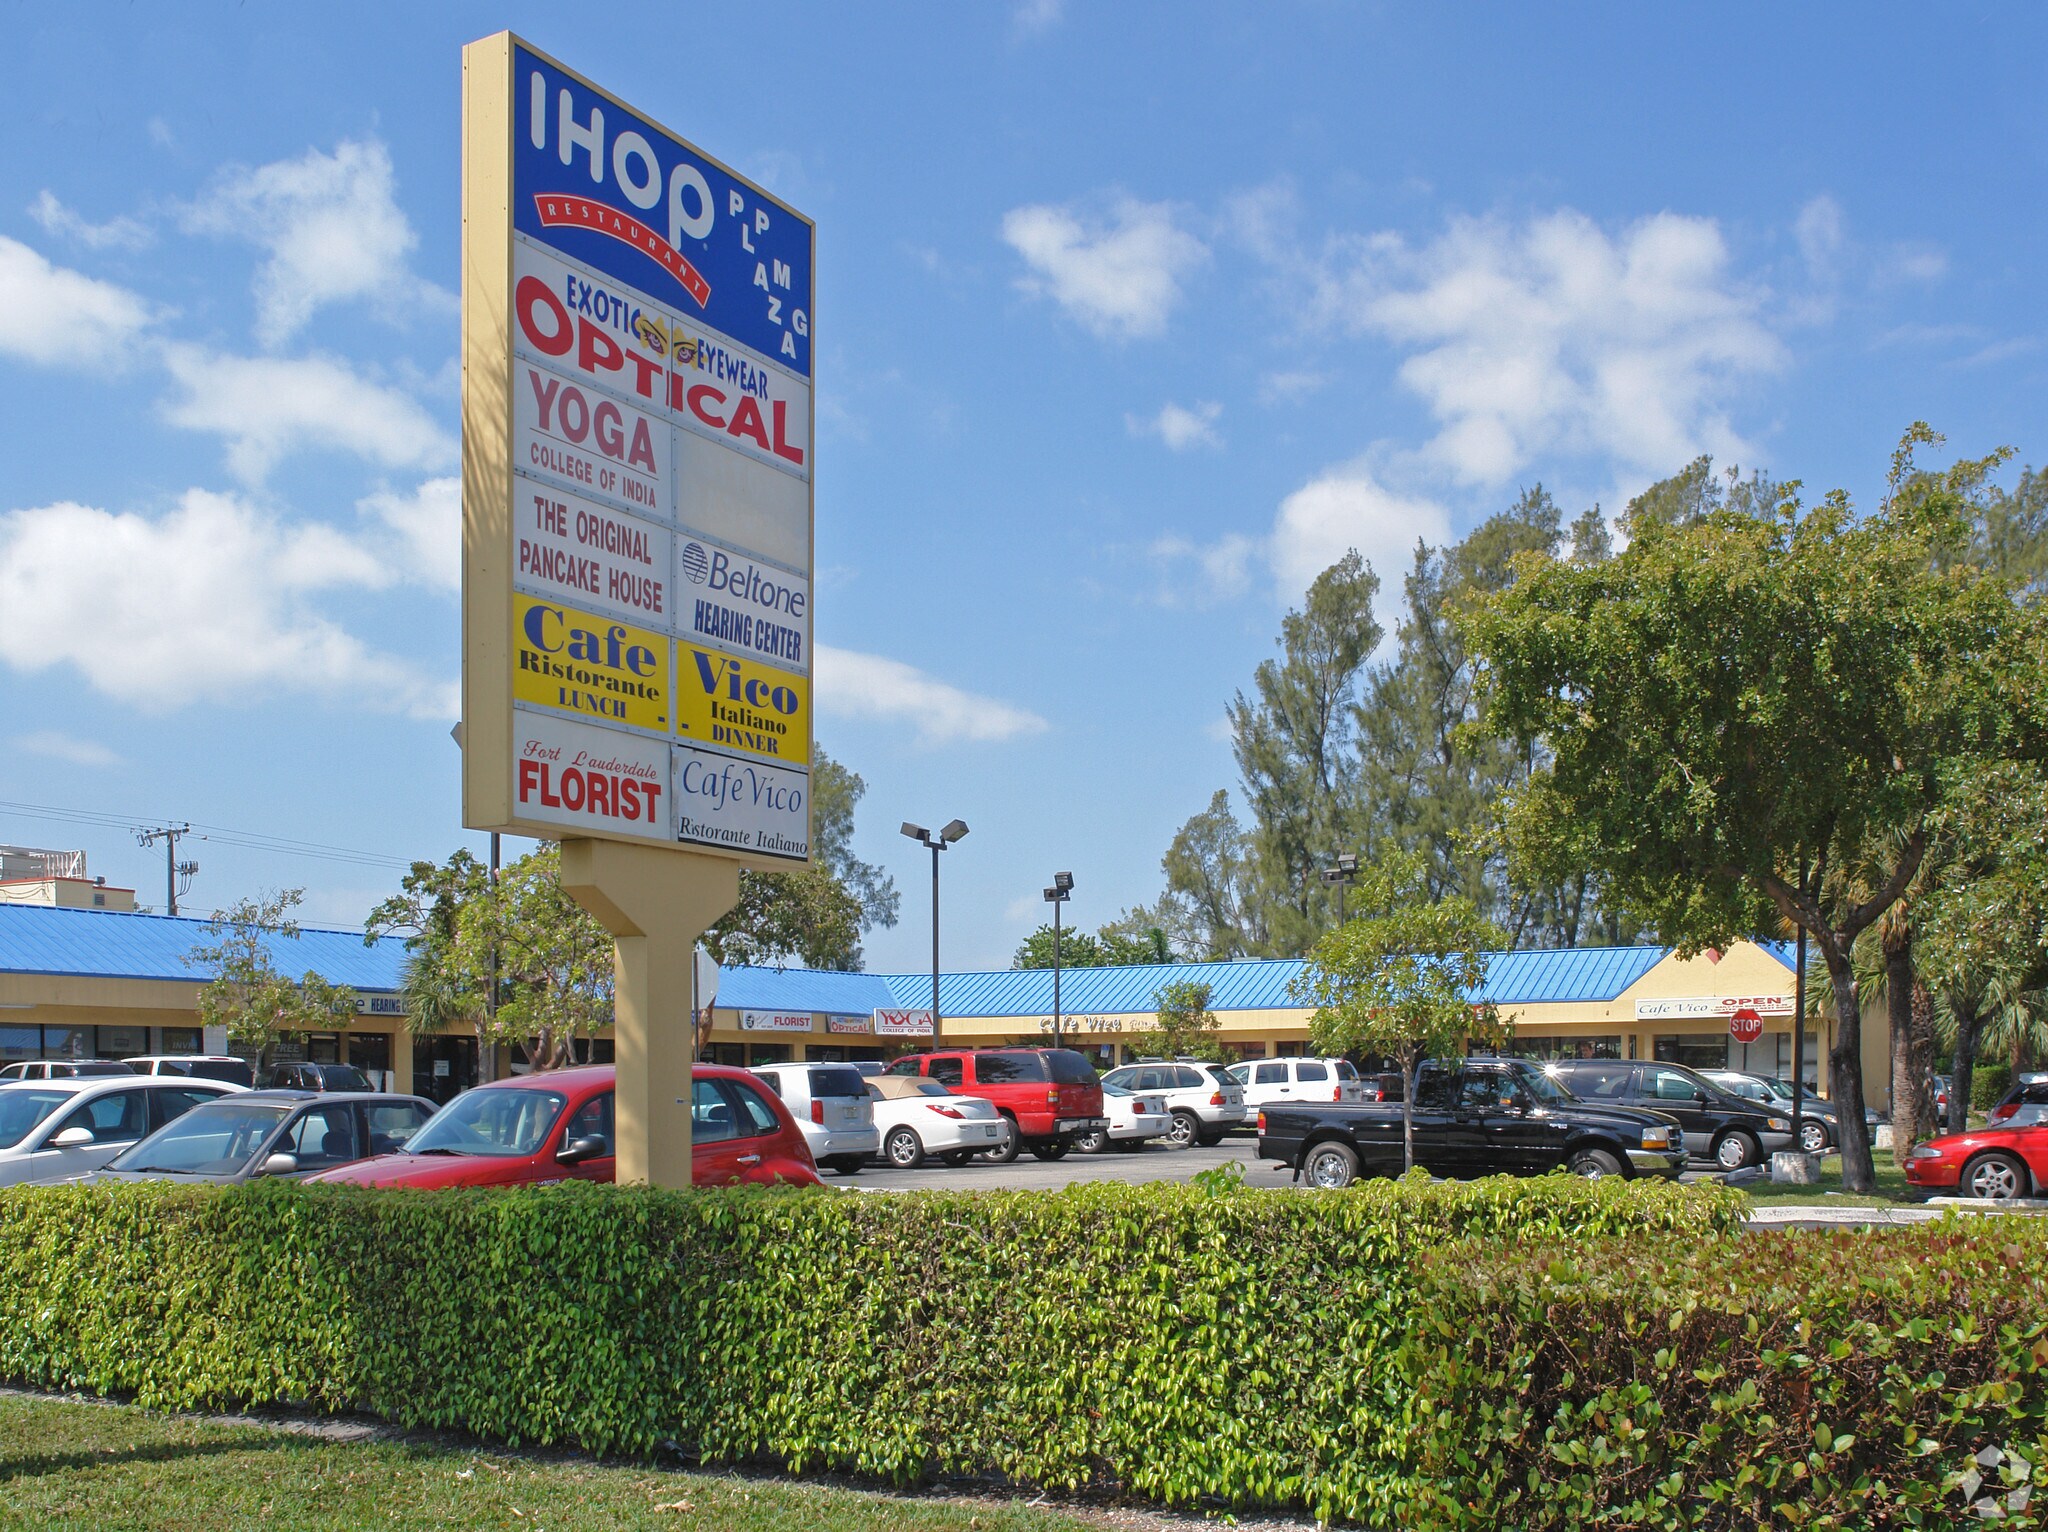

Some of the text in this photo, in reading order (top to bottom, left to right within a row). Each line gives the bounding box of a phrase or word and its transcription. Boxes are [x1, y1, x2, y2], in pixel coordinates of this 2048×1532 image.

[530, 71, 715, 251] IHOP
[547, 202, 701, 291] RESTAURANT
[567, 274, 768, 400] EXOTIC EYEWEAR
[516, 275, 804, 465] OPTICAL
[528, 370, 657, 474] YOGA
[530, 441, 656, 508] COLLEGE OF INDIA
[534, 496, 652, 565] THE ORIGINAL
[520, 539, 663, 614] PANCAKE HOUSE
[708, 551, 805, 618] Beltone
[523, 605, 798, 715] Cafe Vico
[694, 599, 801, 662] HEARING CENTER
[519, 649, 787, 736] Ristorante Italiano
[559, 687, 778, 755] LUNCH DINNER
[519, 759, 662, 823] FLORIST
[523, 740, 657, 780] Fort Lauderdale
[680, 817, 807, 855] Ristorante Italiano
[371, 998, 400, 1012] HEARING
[774, 1016, 810, 1027] FLORIST
[831, 1021, 869, 1033] OPTICAL
[880, 1010, 933, 1026] YOGA
[1084, 1014, 1121, 1029] Vico
[1639, 1003, 1708, 1016] Cafe Vico
[1722, 998, 1781, 1006] OPEN
[1732, 1018, 1761, 1032] STOP
